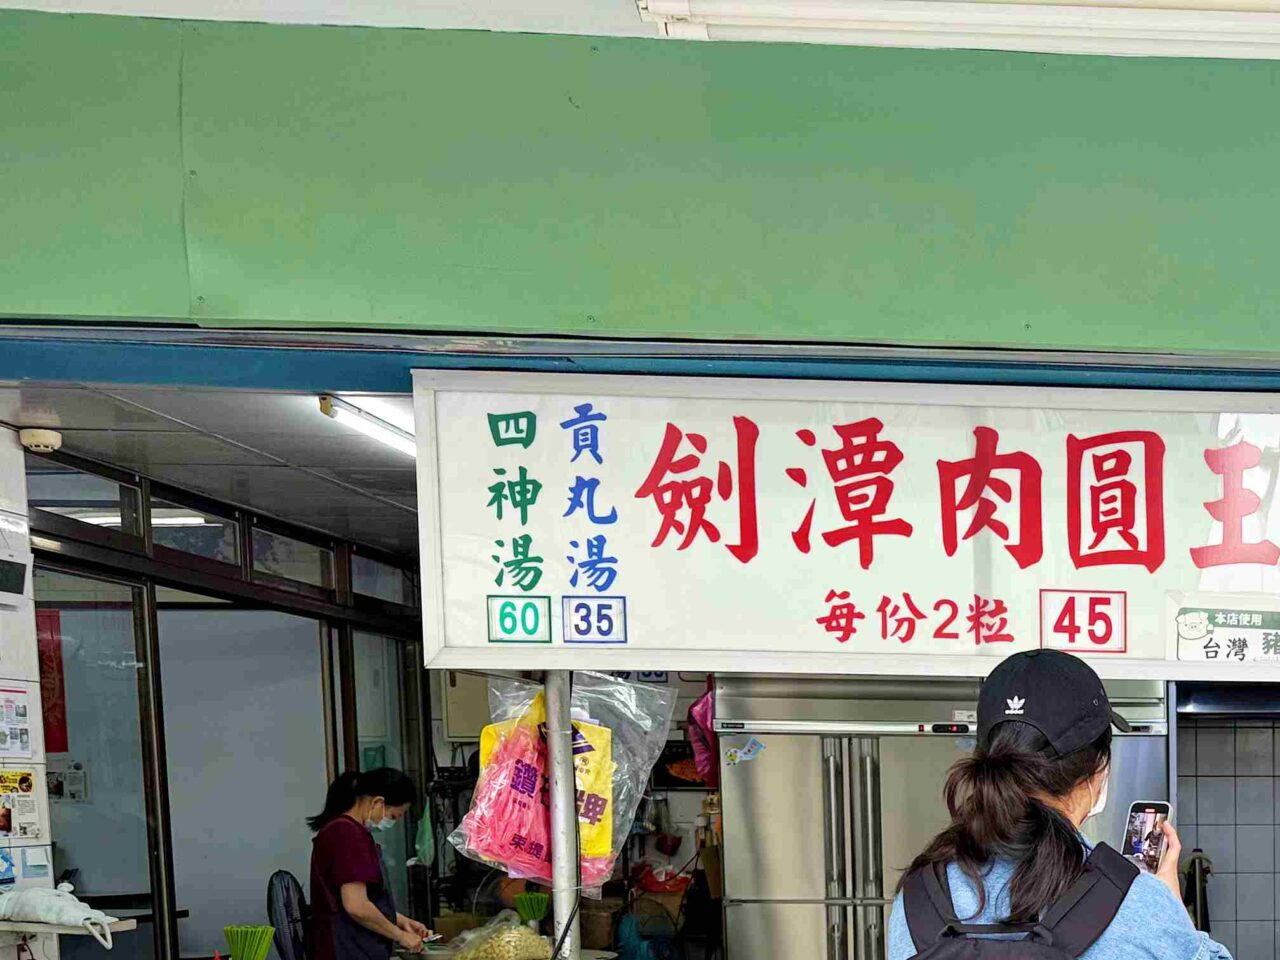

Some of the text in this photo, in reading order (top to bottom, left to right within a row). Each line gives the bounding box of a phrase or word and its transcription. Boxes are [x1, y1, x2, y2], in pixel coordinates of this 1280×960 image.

[487, 411, 543, 592] 四神湯
[560, 403, 618, 589] 貢丸湯
[634, 415, 1280, 574] 劍潭肉圓王
[499, 602, 539, 636] 60
[573, 603, 614, 637] 35
[816, 589, 1113, 646] 每份2粒 45
[1214, 612, 1263, 626] 本店使用
